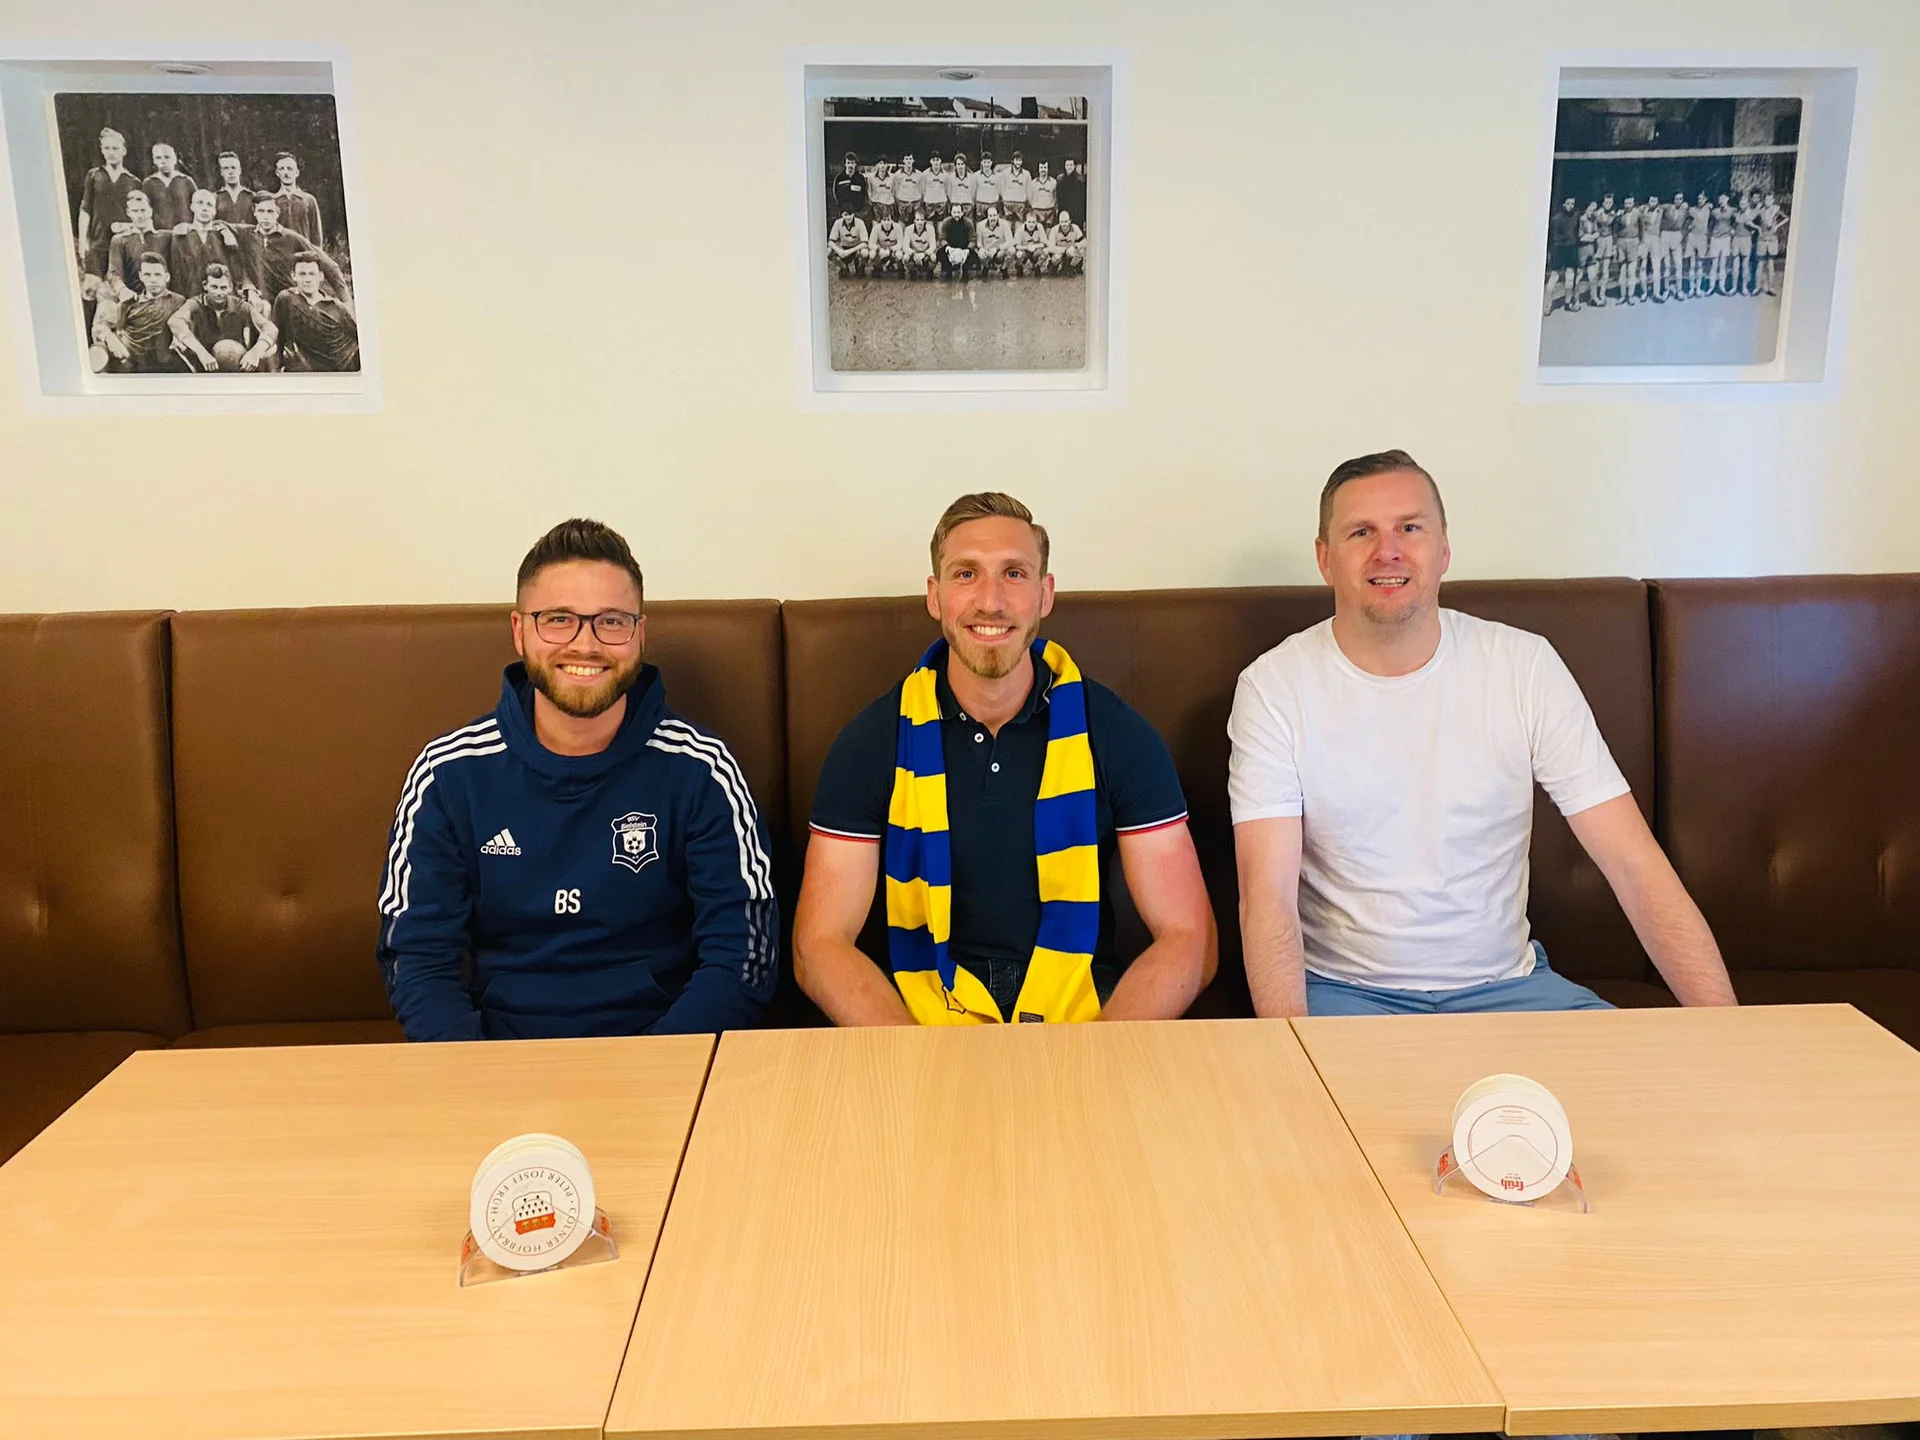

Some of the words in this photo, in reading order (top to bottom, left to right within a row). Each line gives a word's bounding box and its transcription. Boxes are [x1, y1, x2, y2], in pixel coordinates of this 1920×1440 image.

[480, 844, 522, 856] adidas
[554, 888, 581, 914] BS
[512, 1170, 544, 1184] JOSEF
[548, 1172, 573, 1197] PETER
